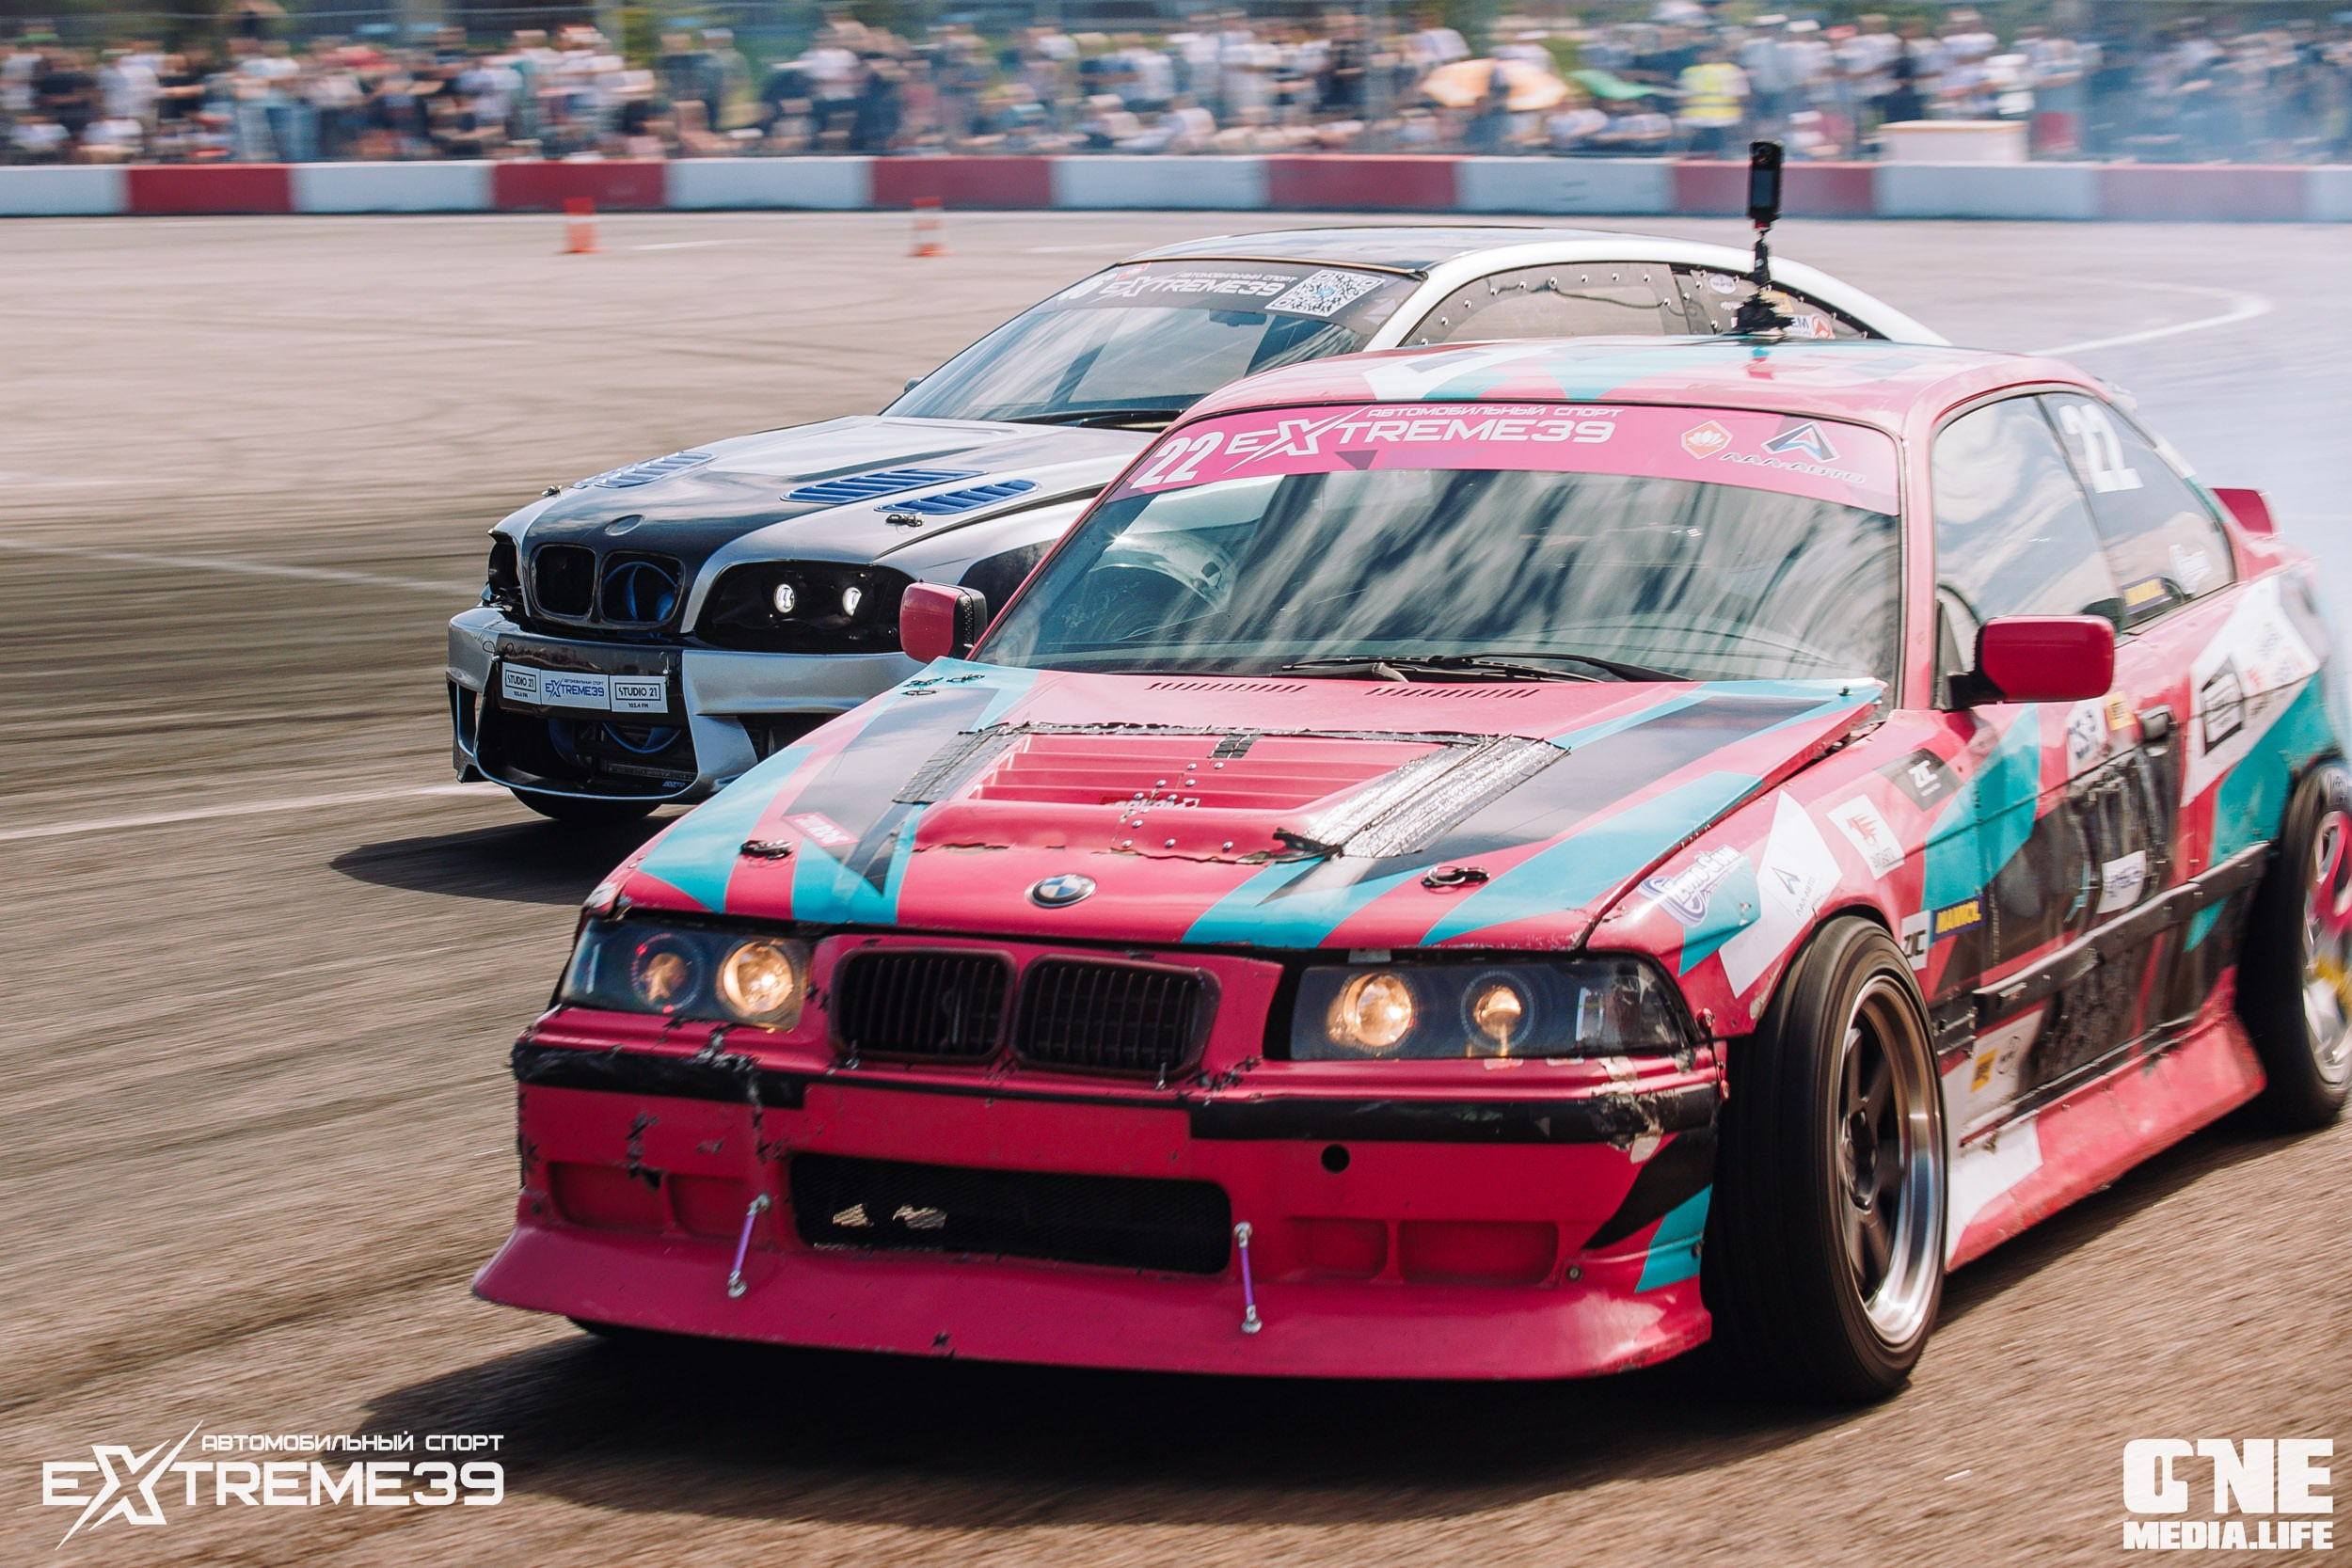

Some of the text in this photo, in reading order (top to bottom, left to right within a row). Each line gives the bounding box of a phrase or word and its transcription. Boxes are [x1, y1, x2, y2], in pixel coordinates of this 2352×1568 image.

[1088, 271, 1286, 304] EXTREME39
[1365, 404, 1624, 419] АВТОМОБИЛЬНЫЙ СПОРТ
[1223, 404, 1617, 475] EXTREME39
[2058, 403, 2144, 493] 22
[1127, 430, 1225, 490] 22
[507, 673, 534, 689] STUDIO 21
[545, 677, 605, 701] EXTREME39
[618, 686, 658, 697] STUDIO 21
